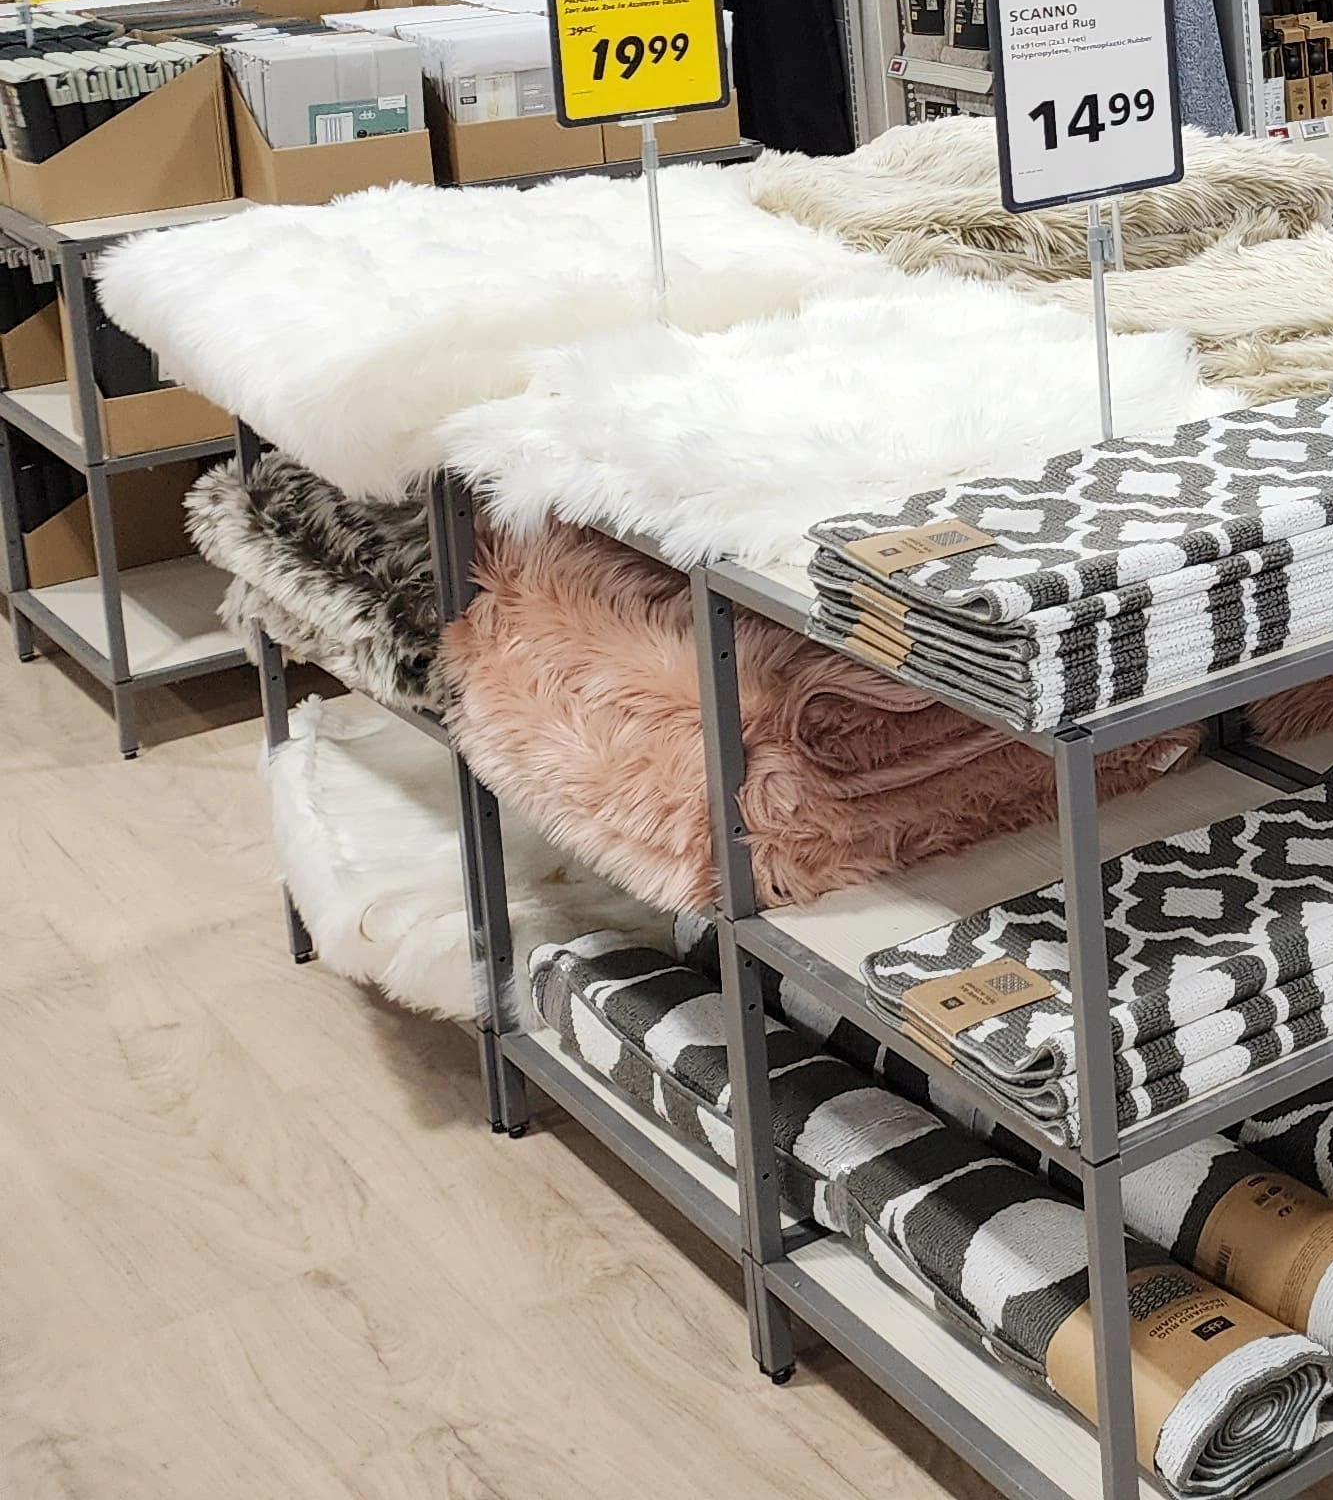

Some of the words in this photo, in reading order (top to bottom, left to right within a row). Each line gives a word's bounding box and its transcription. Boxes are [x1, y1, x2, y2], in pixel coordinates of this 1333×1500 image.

[1009, 3, 1078, 23] SCANNO
[1010, 20, 1069, 37] Jacquard
[1072, 18, 1096, 29] Rug
[1011, 47, 1072, 61] Polypropylene,
[1073, 38, 1126, 52] Thermoplastic
[1127, 35, 1152, 45] Rubber
[1067, 35, 1087, 45] Feet)
[592, 32, 690, 81] 1999
[1027, 88, 1155, 150] 1499
[1157, 1323, 1181, 1340] RUG
